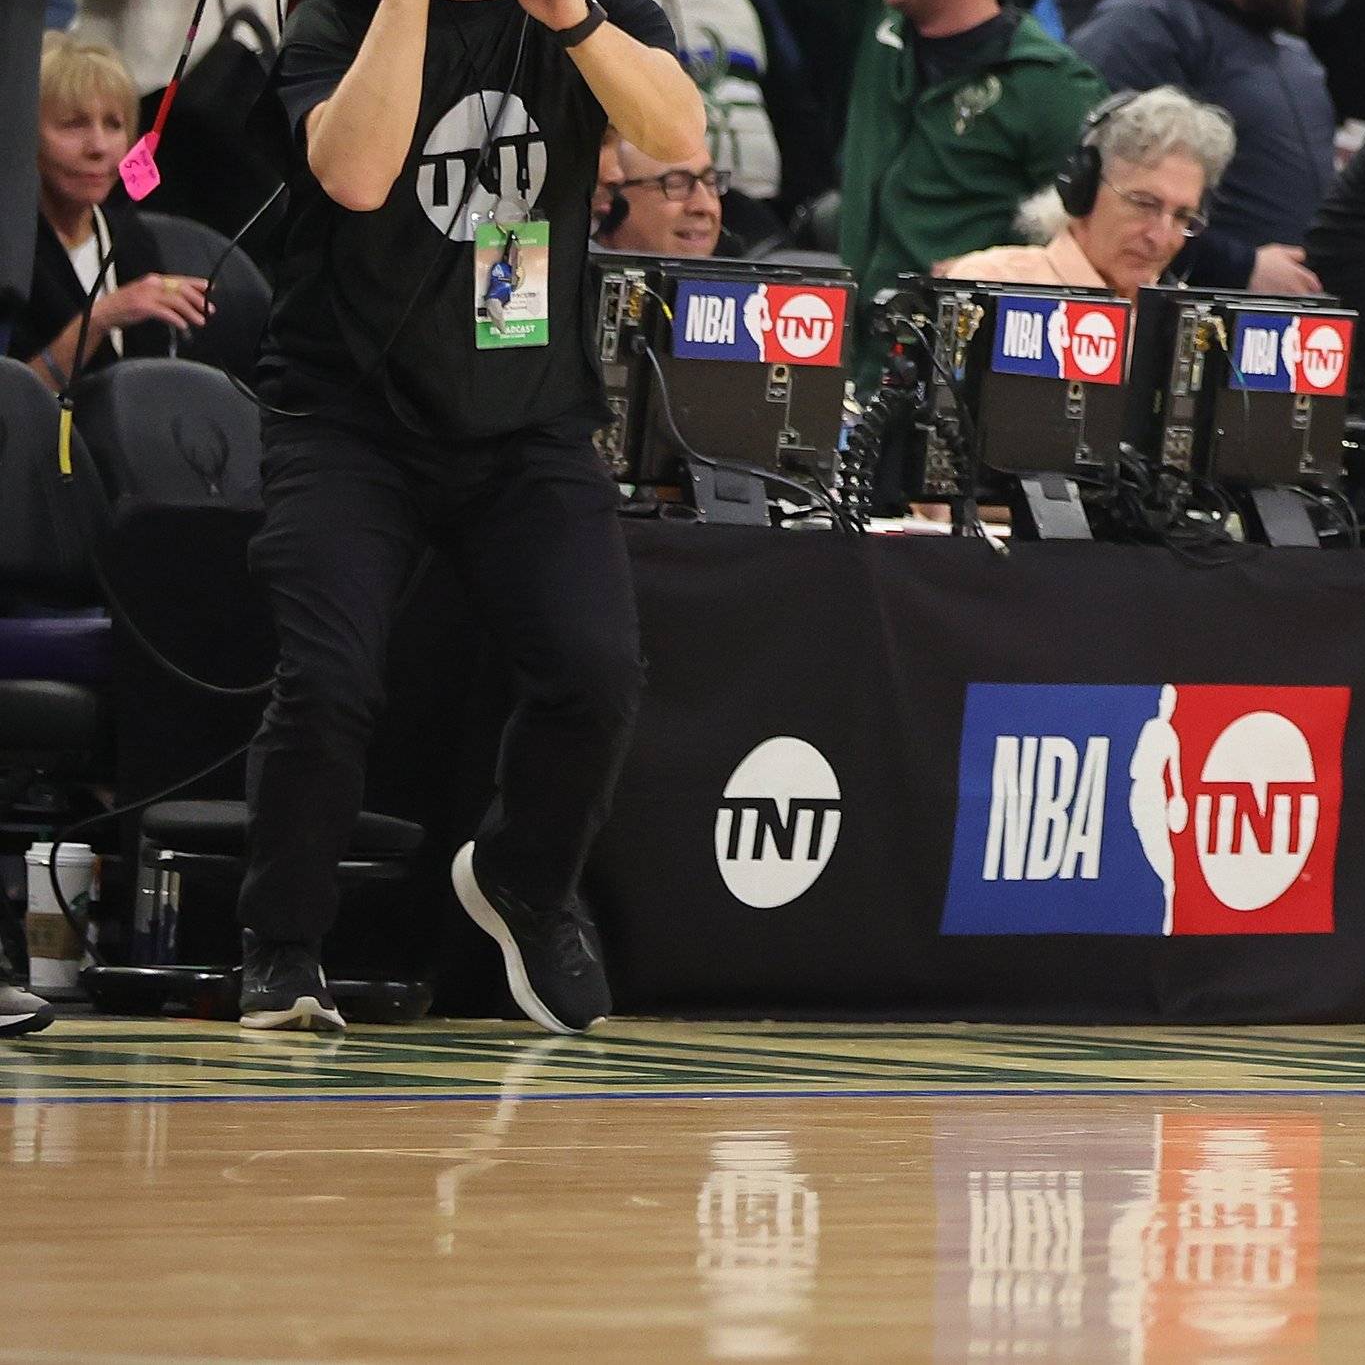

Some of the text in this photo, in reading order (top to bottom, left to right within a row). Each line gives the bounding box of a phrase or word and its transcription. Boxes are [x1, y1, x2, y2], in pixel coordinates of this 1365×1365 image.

[685, 294, 737, 345] NBA
[1003, 309, 1044, 360] NBA
[1241, 327, 1279, 376] NBA
[717, 797, 842, 861] TNT
[982, 735, 1320, 881] NBA TNT
